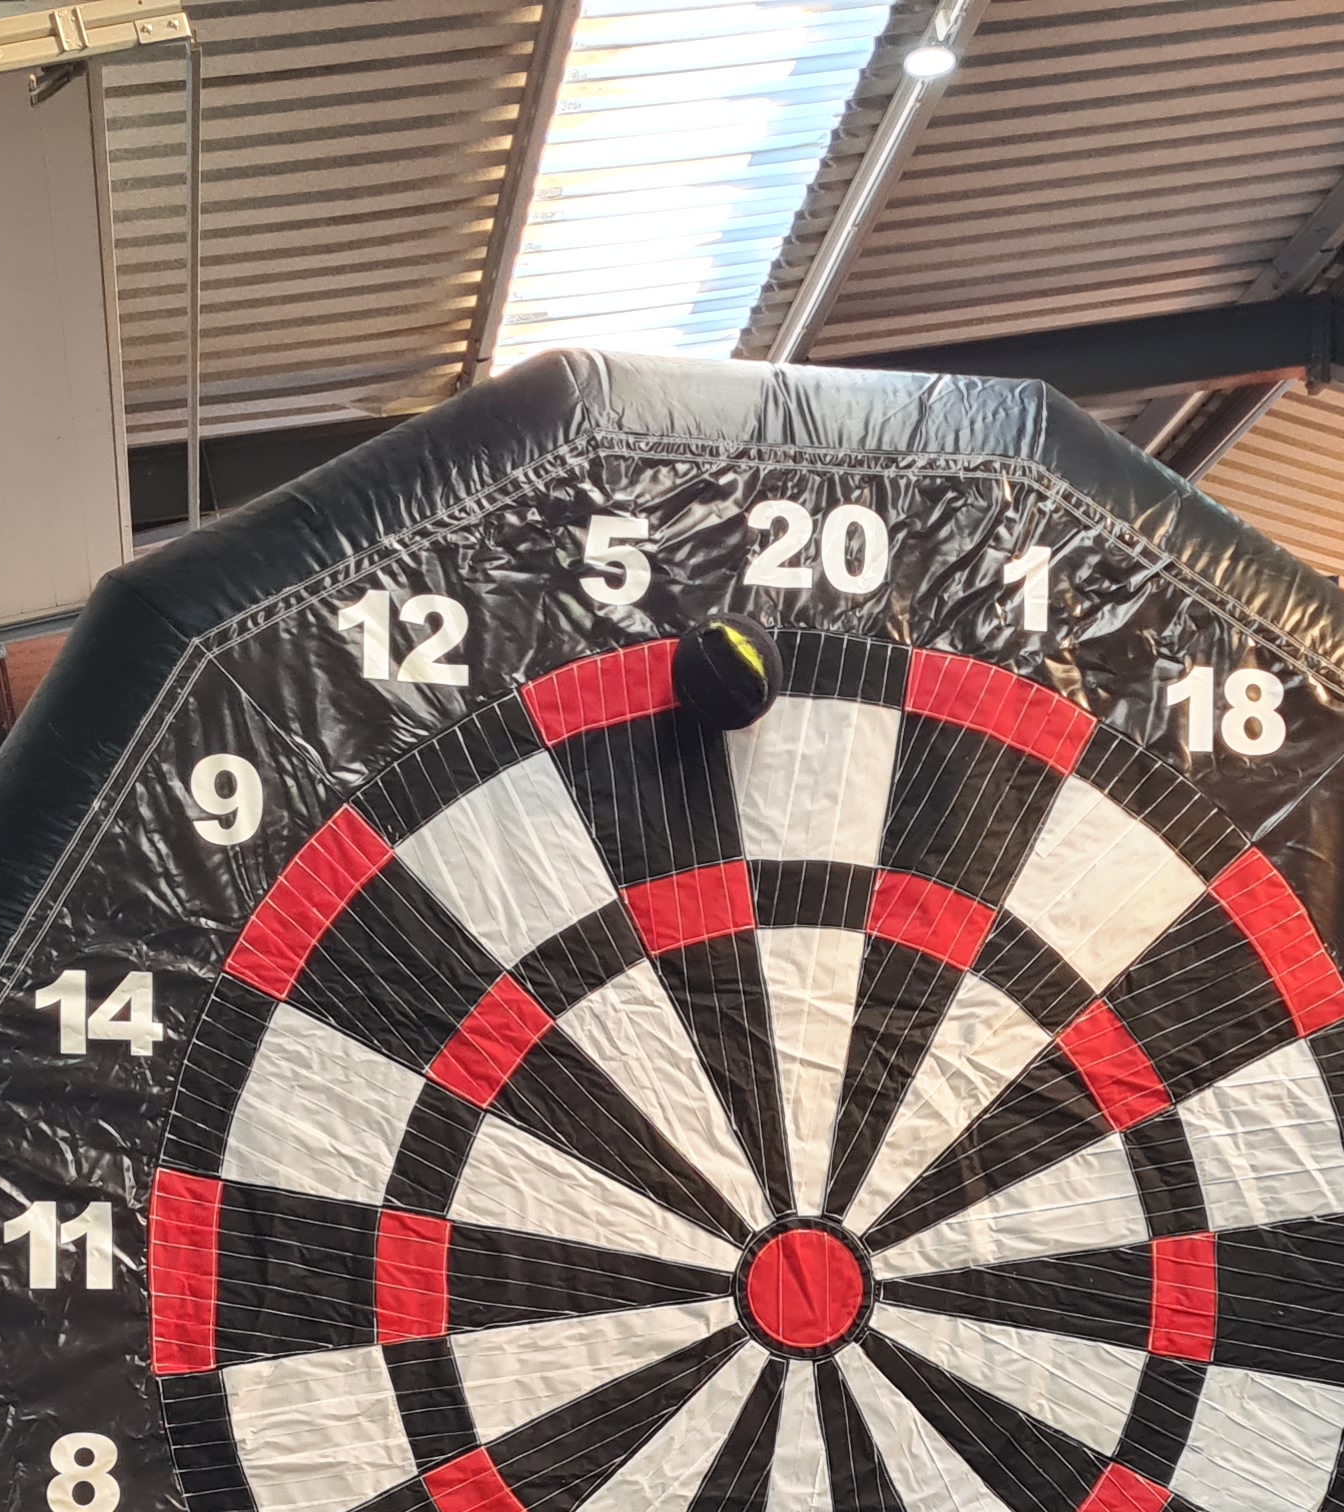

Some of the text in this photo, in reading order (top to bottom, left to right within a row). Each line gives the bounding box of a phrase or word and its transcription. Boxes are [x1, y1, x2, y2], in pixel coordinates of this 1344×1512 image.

[579, 514, 653, 608] 5
[744, 498, 890, 595] 20
[1003, 544, 1050, 633] 1
[336, 593, 469, 688] 12
[1164, 664, 1288, 757] 18
[190, 754, 263, 848] 9
[35, 970, 163, 1056] 14
[4, 1199, 115, 1289] 11
